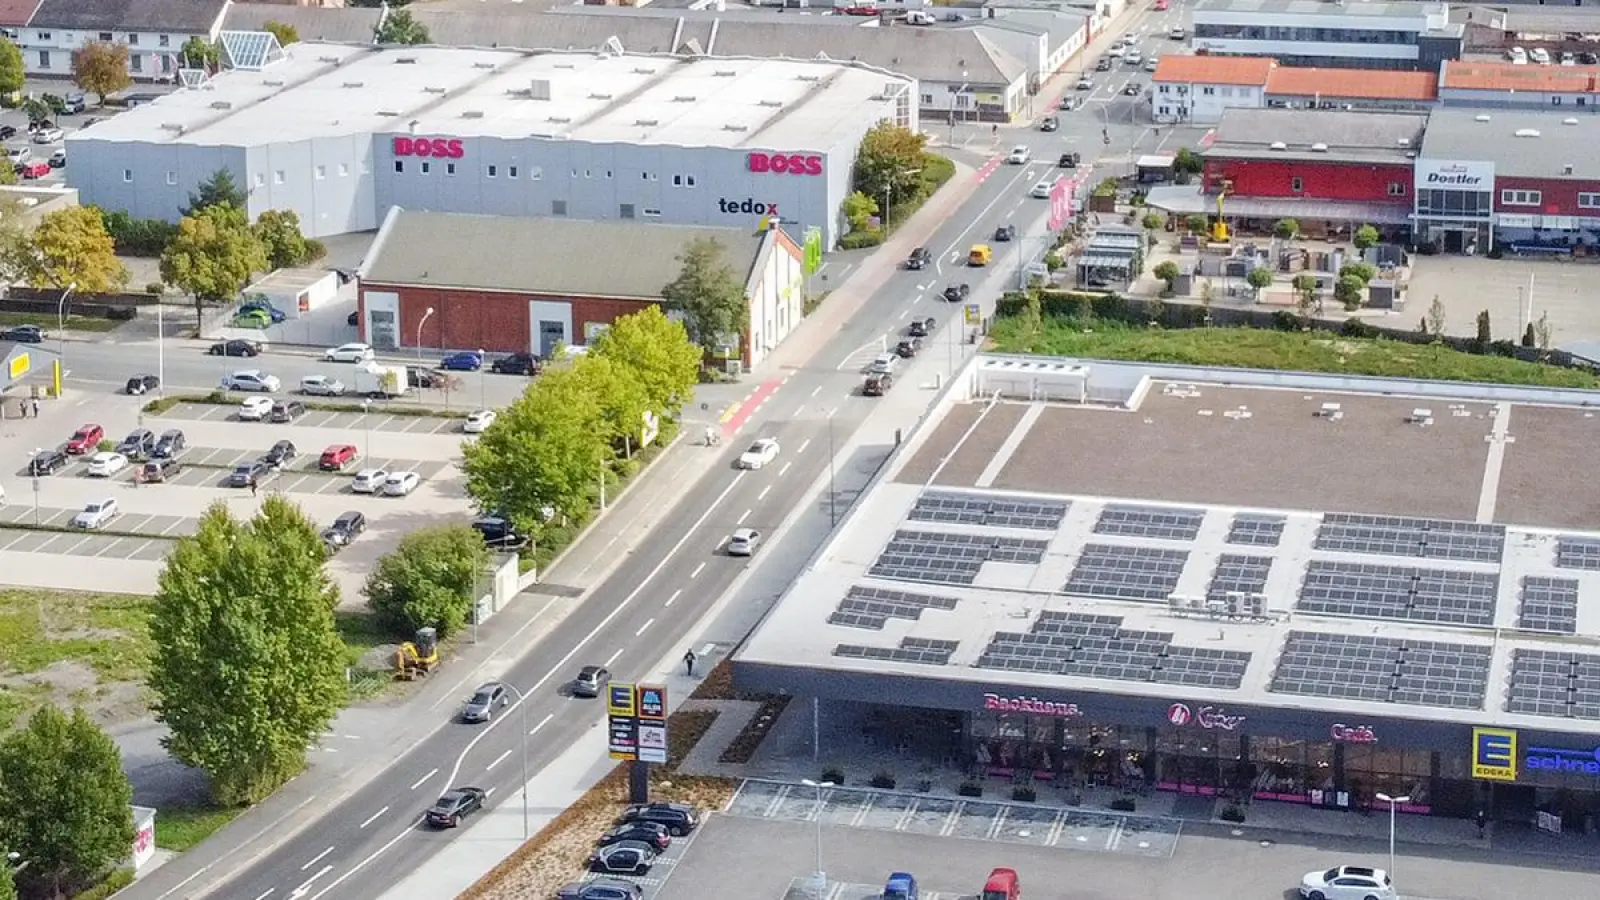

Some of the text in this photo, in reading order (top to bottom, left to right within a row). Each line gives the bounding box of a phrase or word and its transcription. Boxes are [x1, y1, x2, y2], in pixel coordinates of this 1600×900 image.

[394, 137, 464, 158] BOSS
[750, 154, 823, 175] BOSS
[1427, 173, 1481, 184] Dostler
[719, 198, 778, 214] tedox
[1476, 768, 1511, 777] EDEKA
[1526, 755, 1600, 773] schne
